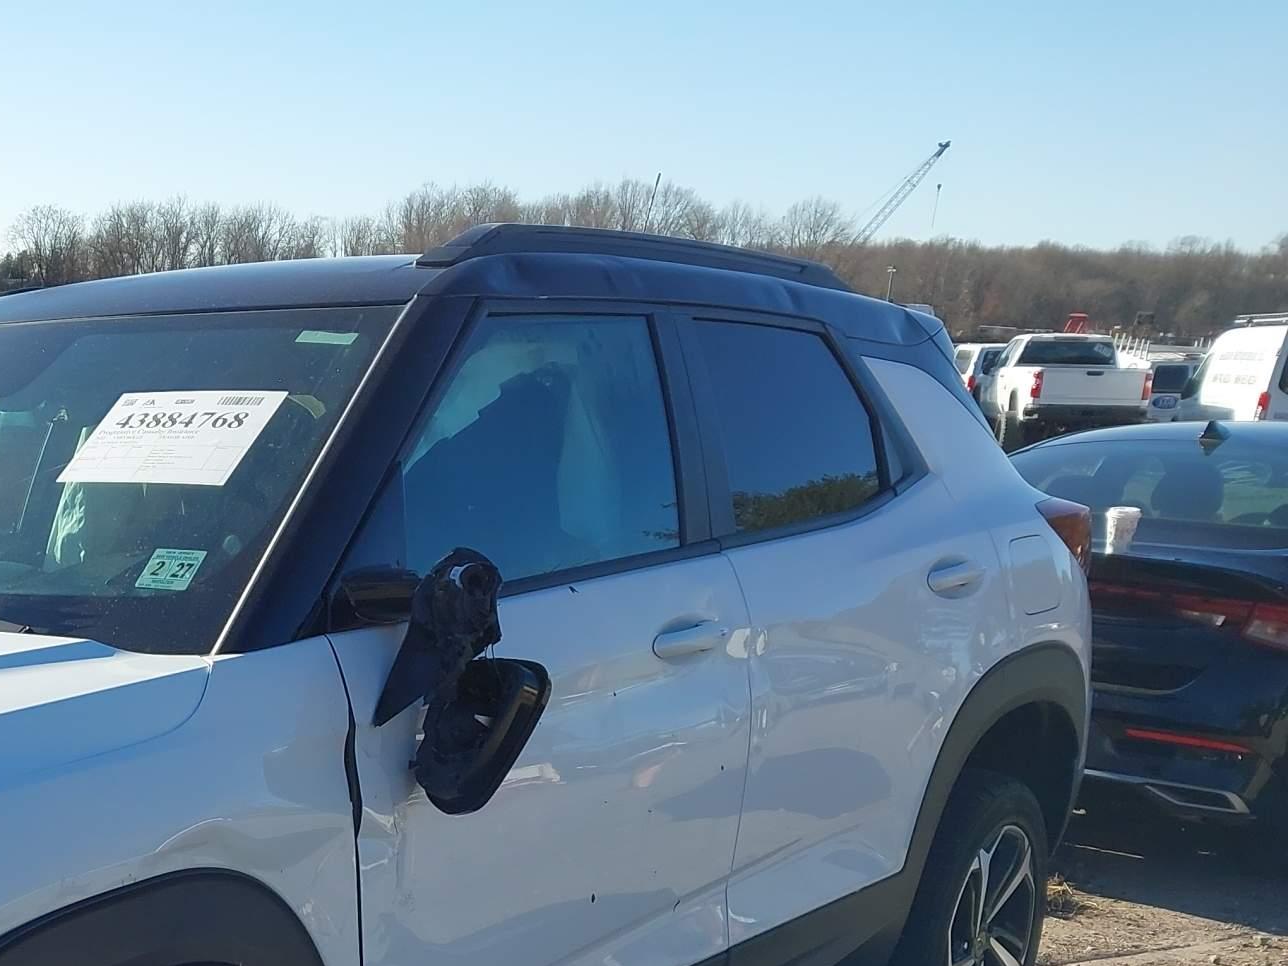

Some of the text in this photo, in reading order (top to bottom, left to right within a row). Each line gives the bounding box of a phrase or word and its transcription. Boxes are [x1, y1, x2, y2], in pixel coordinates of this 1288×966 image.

[115, 411, 249, 428] 43884768
[150, 561, 195, 578] 2 27
